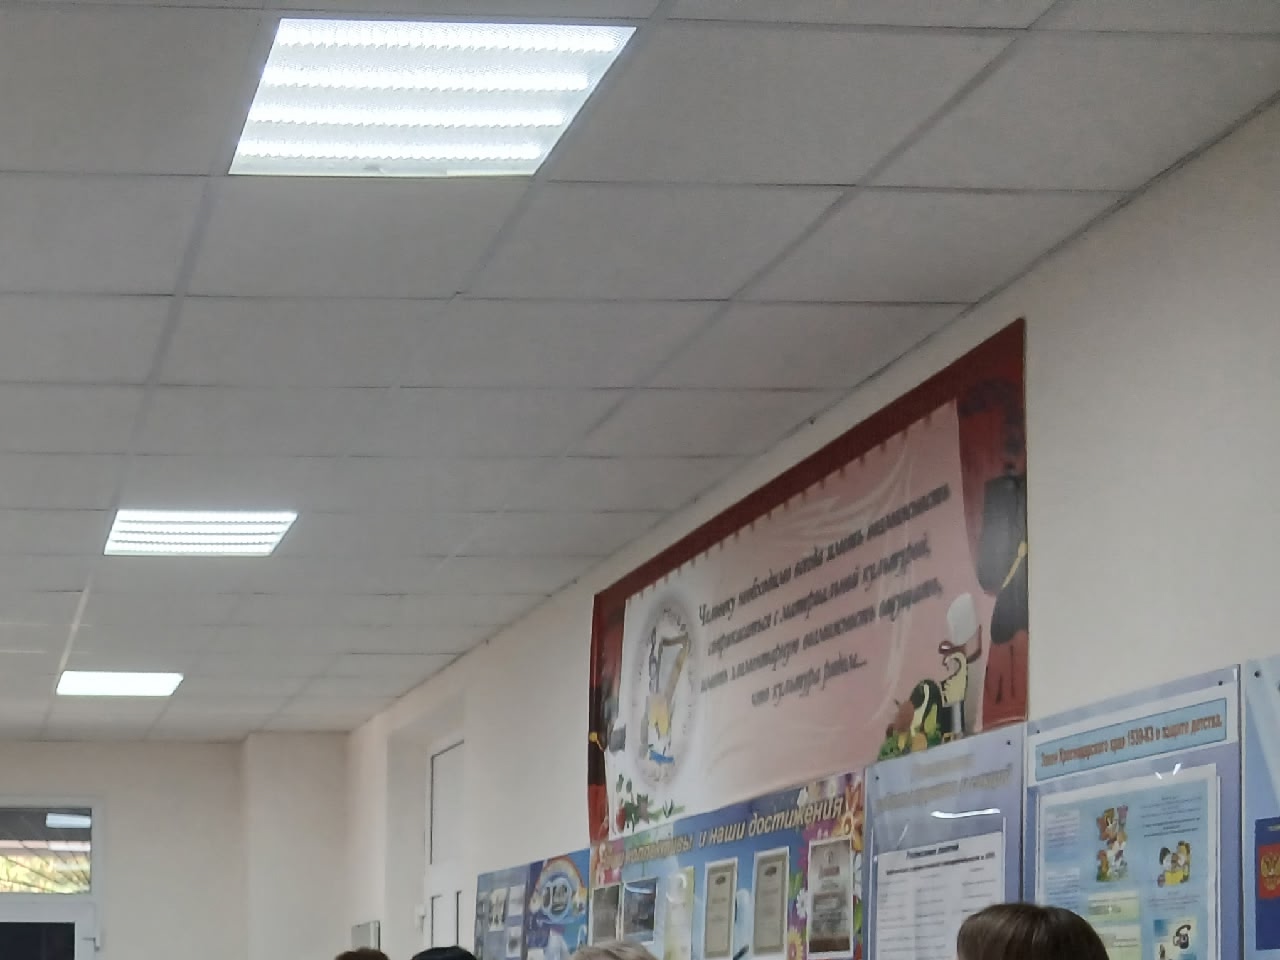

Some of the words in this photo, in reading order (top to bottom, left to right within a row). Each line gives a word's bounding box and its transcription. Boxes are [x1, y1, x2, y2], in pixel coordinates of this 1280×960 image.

[698, 830, 710, 849] и
[710, 820, 746, 844] наши
[747, 797, 845, 838] достижения
